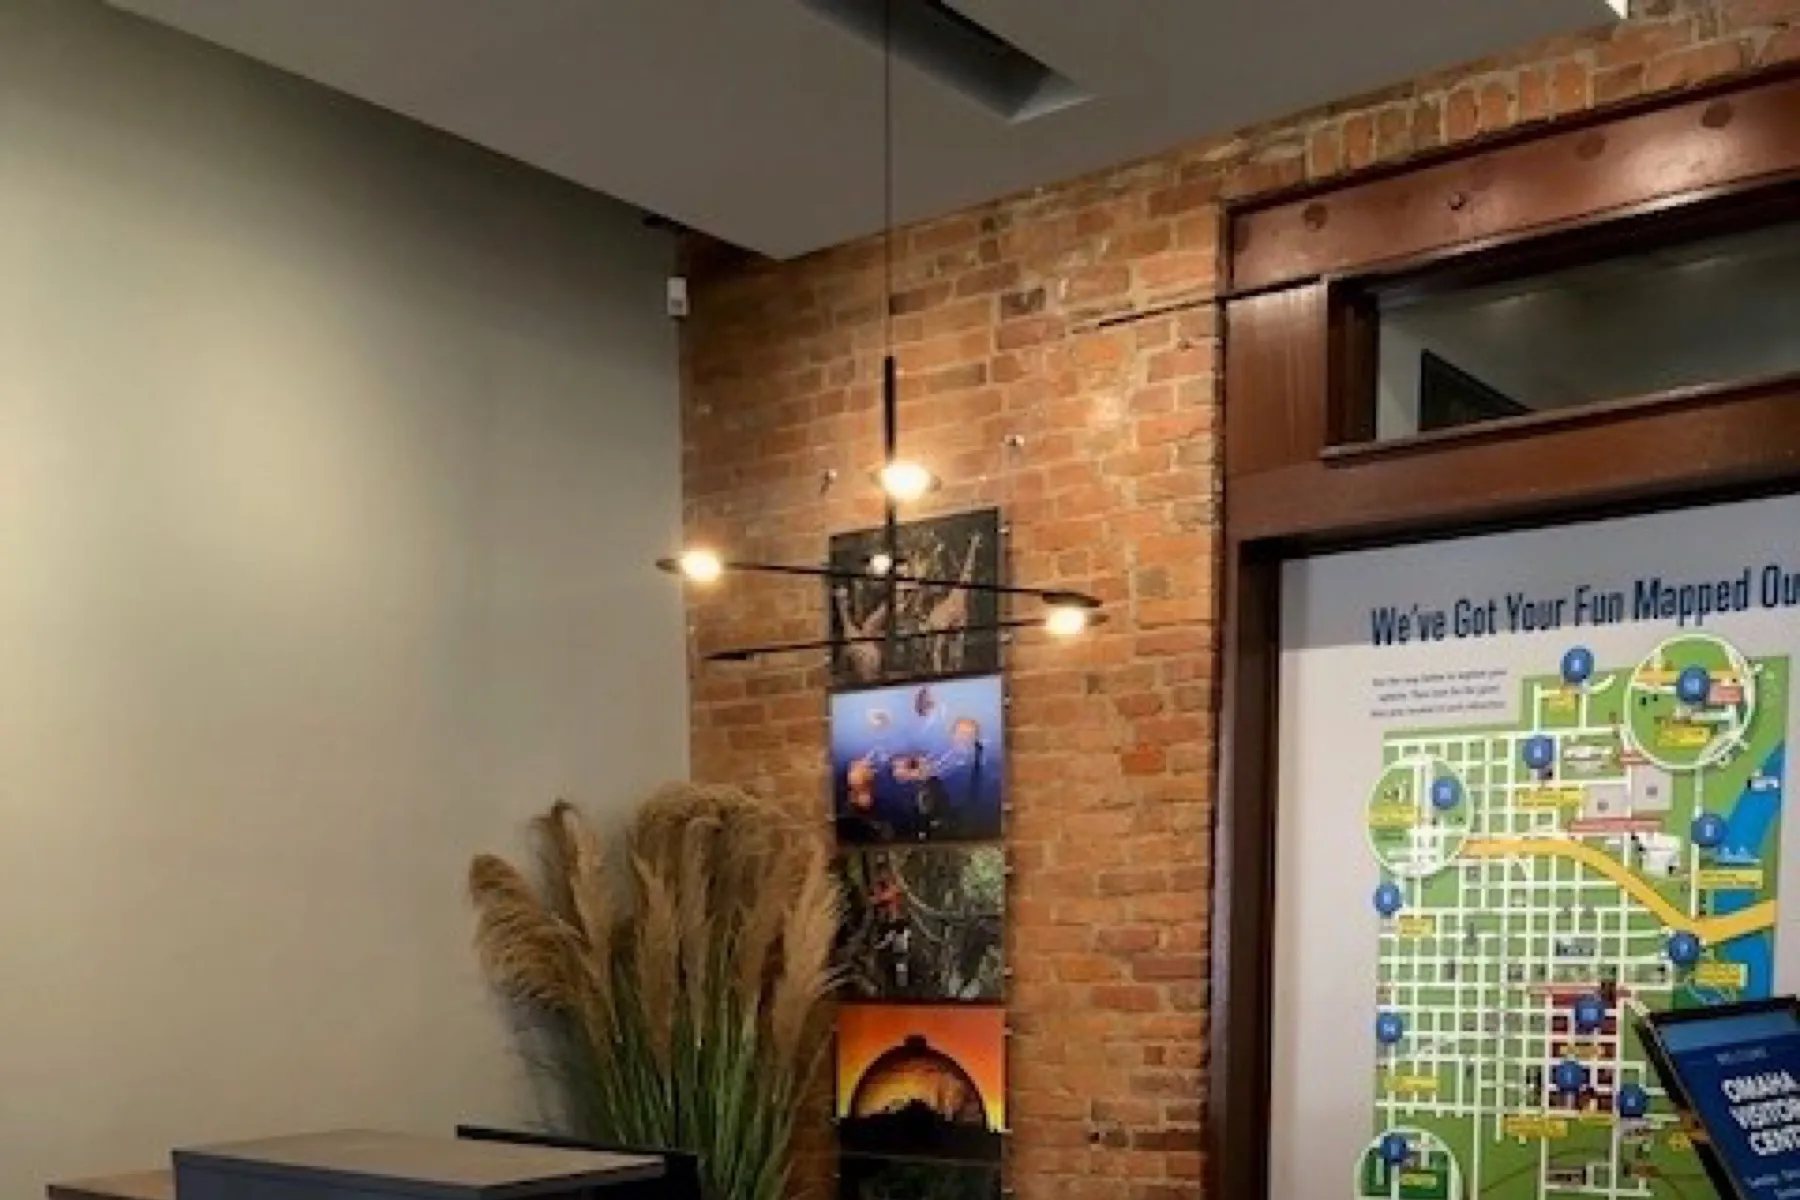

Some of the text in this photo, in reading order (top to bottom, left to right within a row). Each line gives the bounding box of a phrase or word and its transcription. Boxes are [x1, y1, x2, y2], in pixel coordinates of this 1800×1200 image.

[1371, 603, 1445, 646] We've
[1454, 595, 1497, 638] Got
[1505, 591, 1567, 634] Your
[1574, 583, 1625, 627] Fun
[1634, 565, 1751, 627] Mapped
[1720, 1069, 1800, 1103] OMAHA
